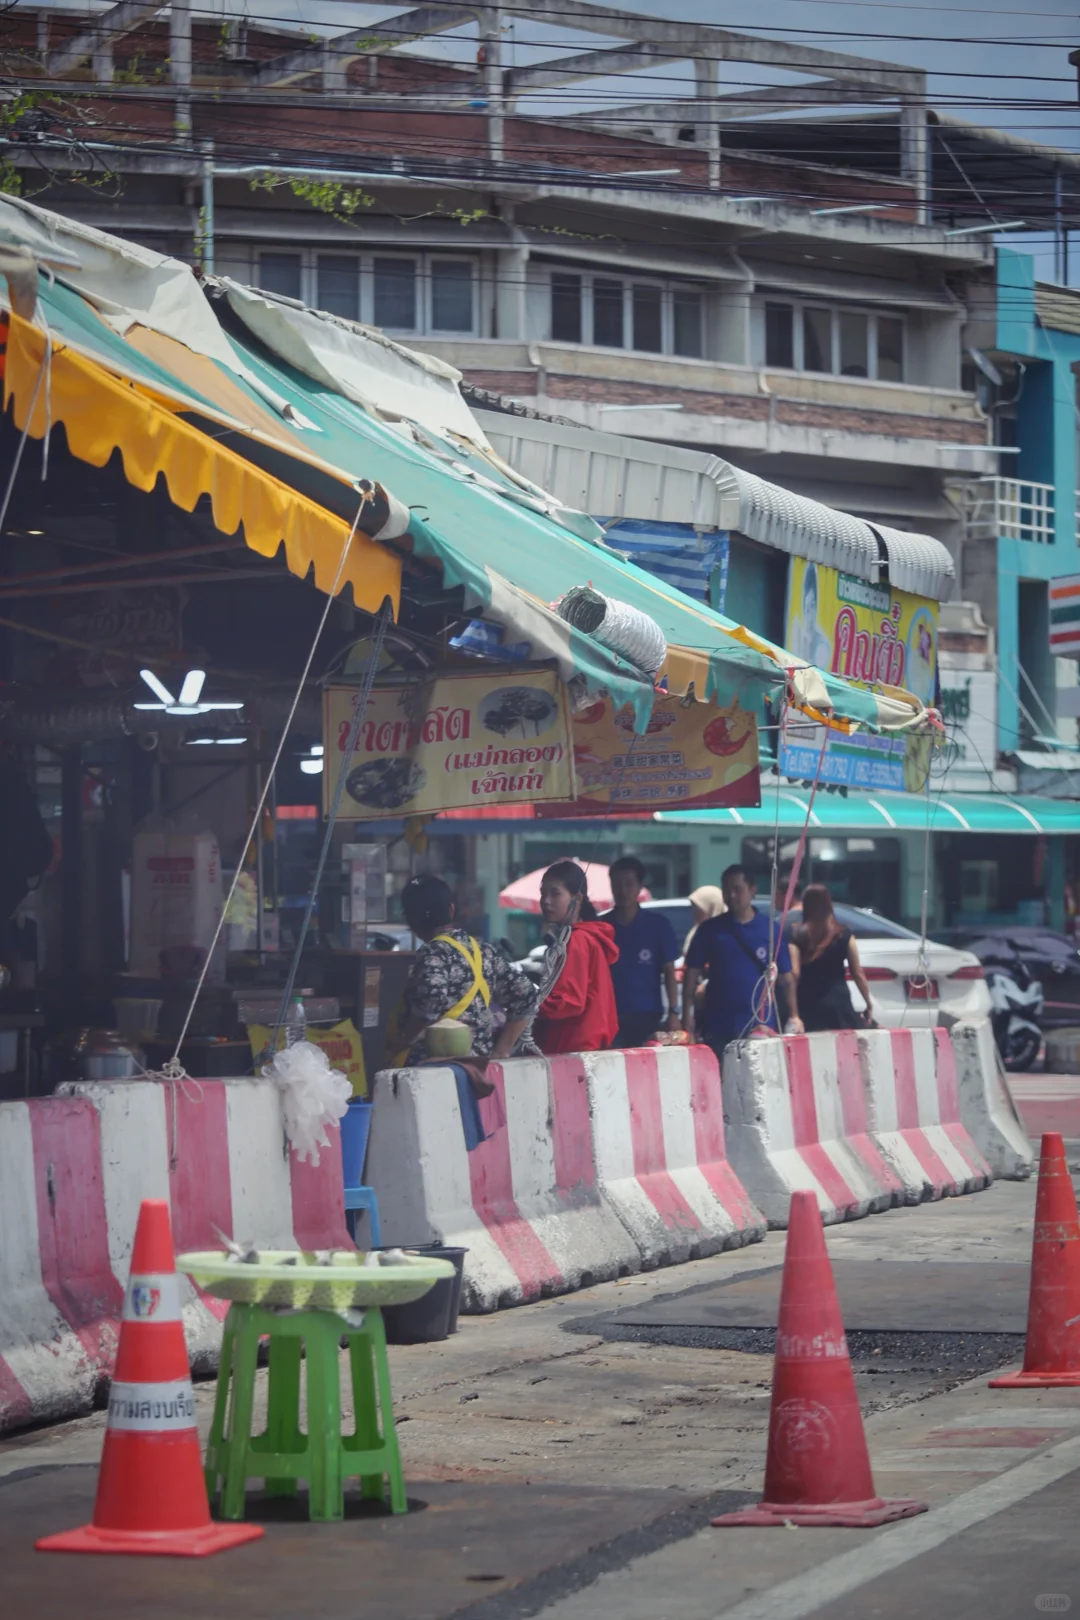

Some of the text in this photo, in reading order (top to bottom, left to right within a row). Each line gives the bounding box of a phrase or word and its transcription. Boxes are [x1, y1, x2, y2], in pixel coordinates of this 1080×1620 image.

[445, 743, 563, 772] (แม่กลอง)
[471, 768, 544, 794] เจ้าเก่า
